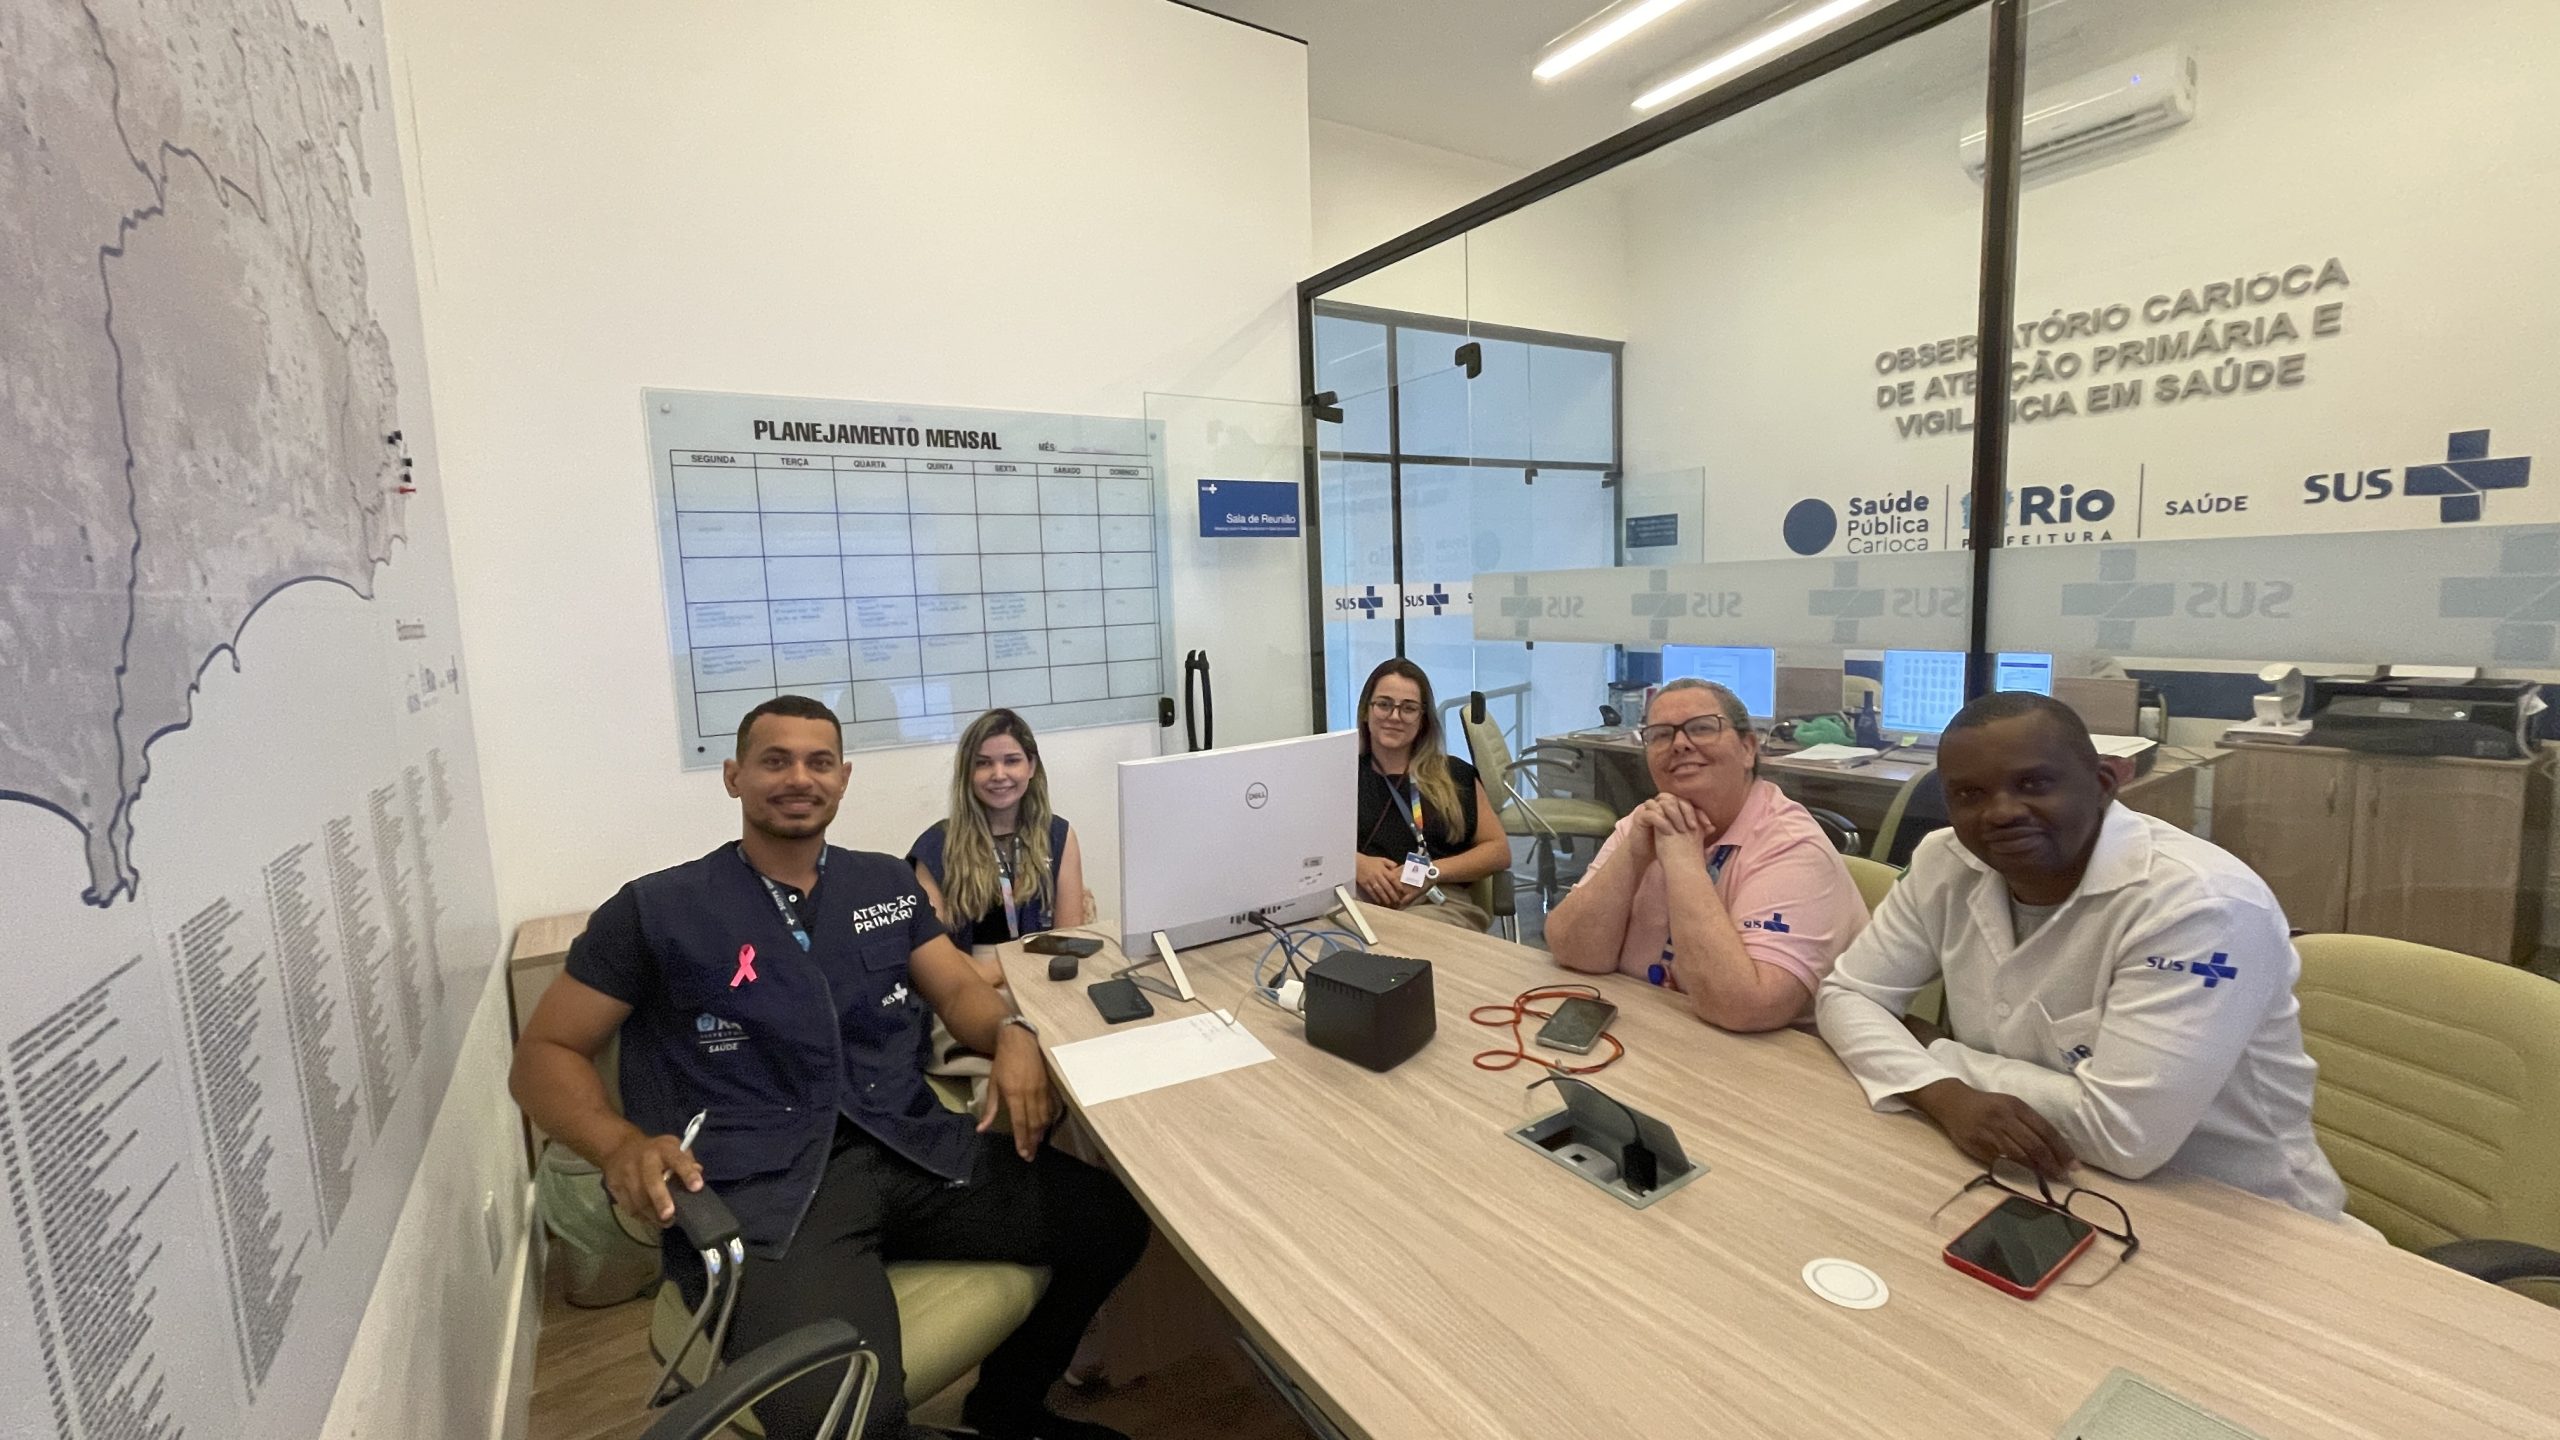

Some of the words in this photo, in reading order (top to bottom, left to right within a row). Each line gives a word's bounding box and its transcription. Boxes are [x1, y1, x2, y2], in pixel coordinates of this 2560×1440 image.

[1875, 303, 2131, 374] OBSERTÓRIO
[2142, 257, 2350, 325] CARIOCA
[1876, 381, 1916, 409] DE
[1923, 350, 2082, 401] ATEÇÃO
[2093, 318, 2299, 374] PRIMÁRIA
[2314, 302, 2344, 336] E
[1895, 391, 2078, 438] VIGILCIA
[2087, 379, 2143, 412] EM
[2154, 356, 2306, 402] SAÚDE
[753, 420, 920, 448] PLANEJAMENTO
[926, 429, 1003, 451] MENSAL
[691, 454, 736, 465] SEGUNDA
[781, 457, 809, 467] TERÇA
[853, 460, 886, 469] QUARTA
[926, 462, 954, 471] QUINTA
[994, 465, 1017, 473] SEXTA
[2303, 468, 2394, 505] SUS
[1849, 489, 1930, 517] Saúde
[2020, 483, 2115, 526] Rio
[2165, 492, 2249, 516] SAÚDE
[1226, 513, 1246, 524] Sala
[1248, 514, 1260, 524] de
[1261, 513, 1297, 524] Reunião
[1847, 515, 1929, 537] Pública
[1847, 536, 1929, 555] Carioca
[1962, 529, 2113, 549] PFEITURA
[1335, 597, 1357, 611] SUS
[1405, 595, 1425, 608] SUS
[853, 895, 917, 922] ATENÇÃO
[854, 907, 913, 935] PRIMÁRI
[2146, 955, 2185, 972] SUS
